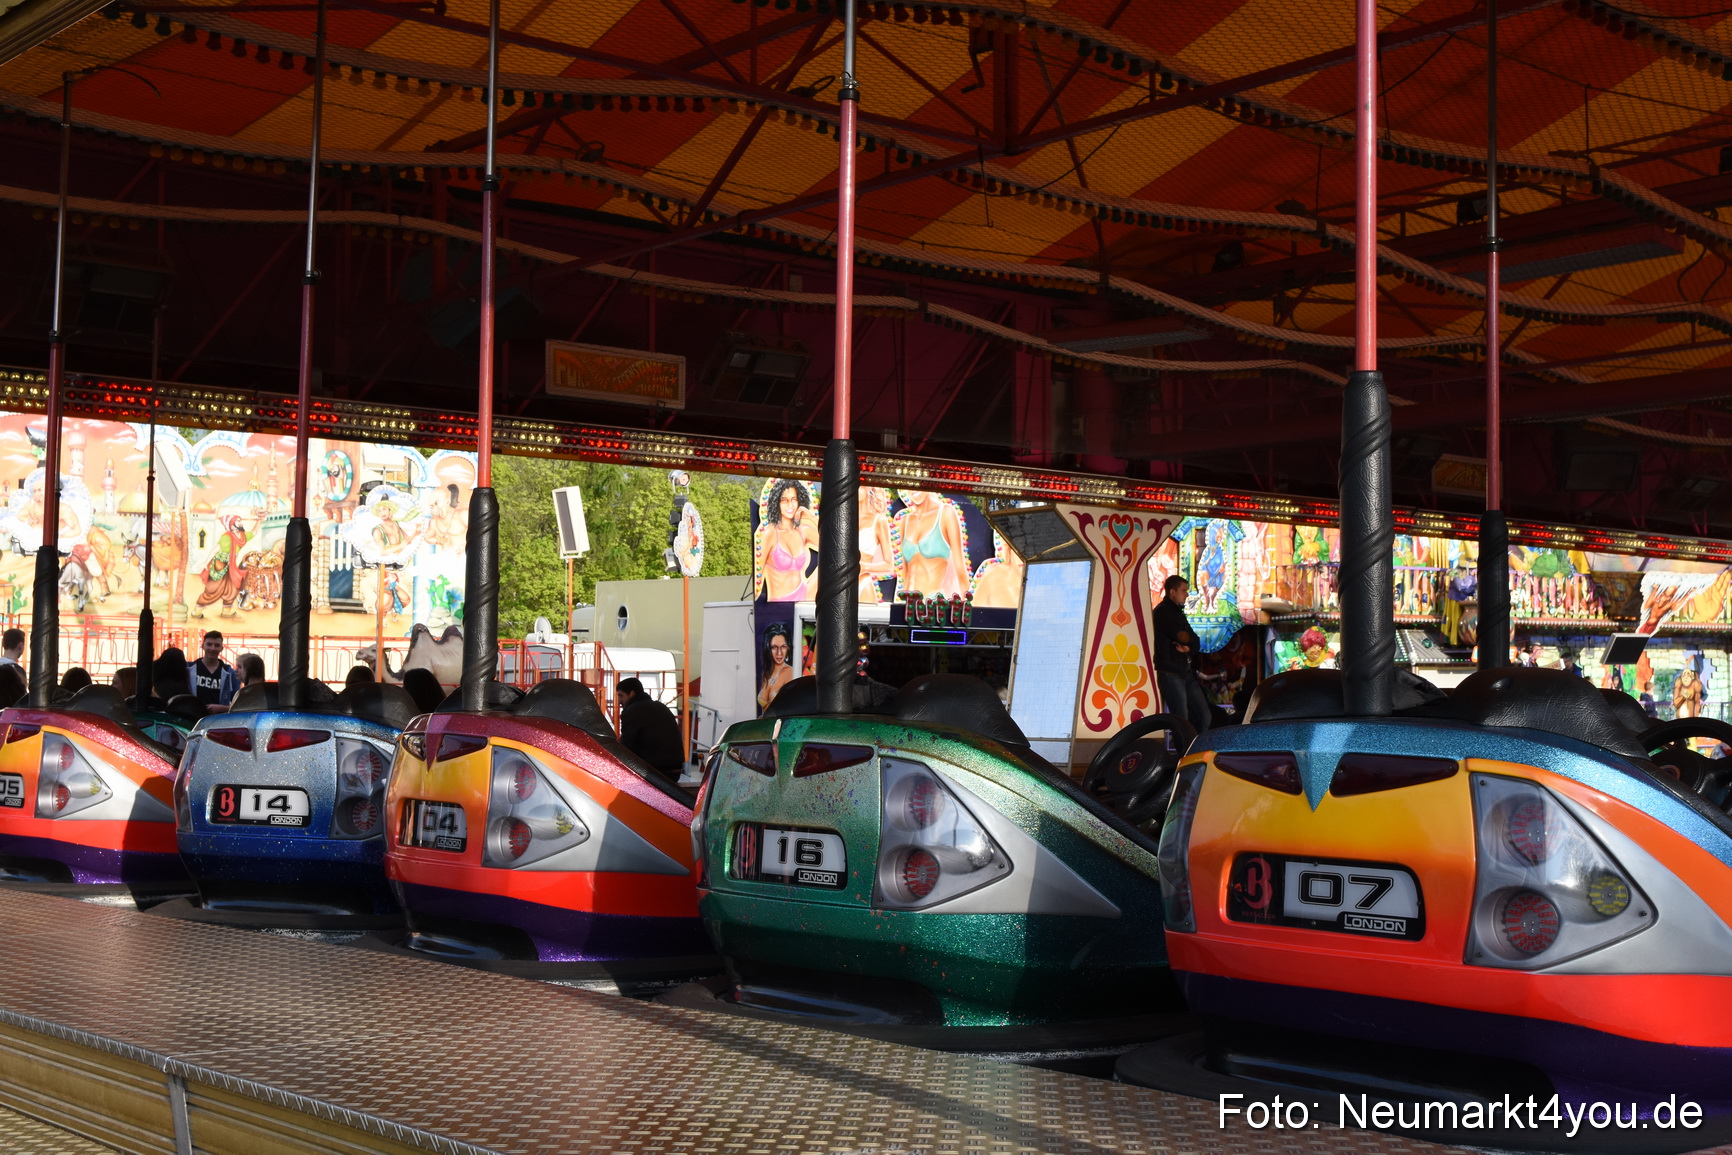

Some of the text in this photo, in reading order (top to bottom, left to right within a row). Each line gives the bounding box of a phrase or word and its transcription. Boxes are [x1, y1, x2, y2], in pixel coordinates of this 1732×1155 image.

[251, 793, 292, 813] 14
[271, 815, 302, 826] LONDON
[423, 808, 458, 835] 04
[437, 838, 462, 849] LONDON
[777, 836, 825, 867] 16
[798, 870, 838, 885] LONDON
[1298, 870, 1394, 910] 07
[1344, 914, 1406, 934] LONDON
